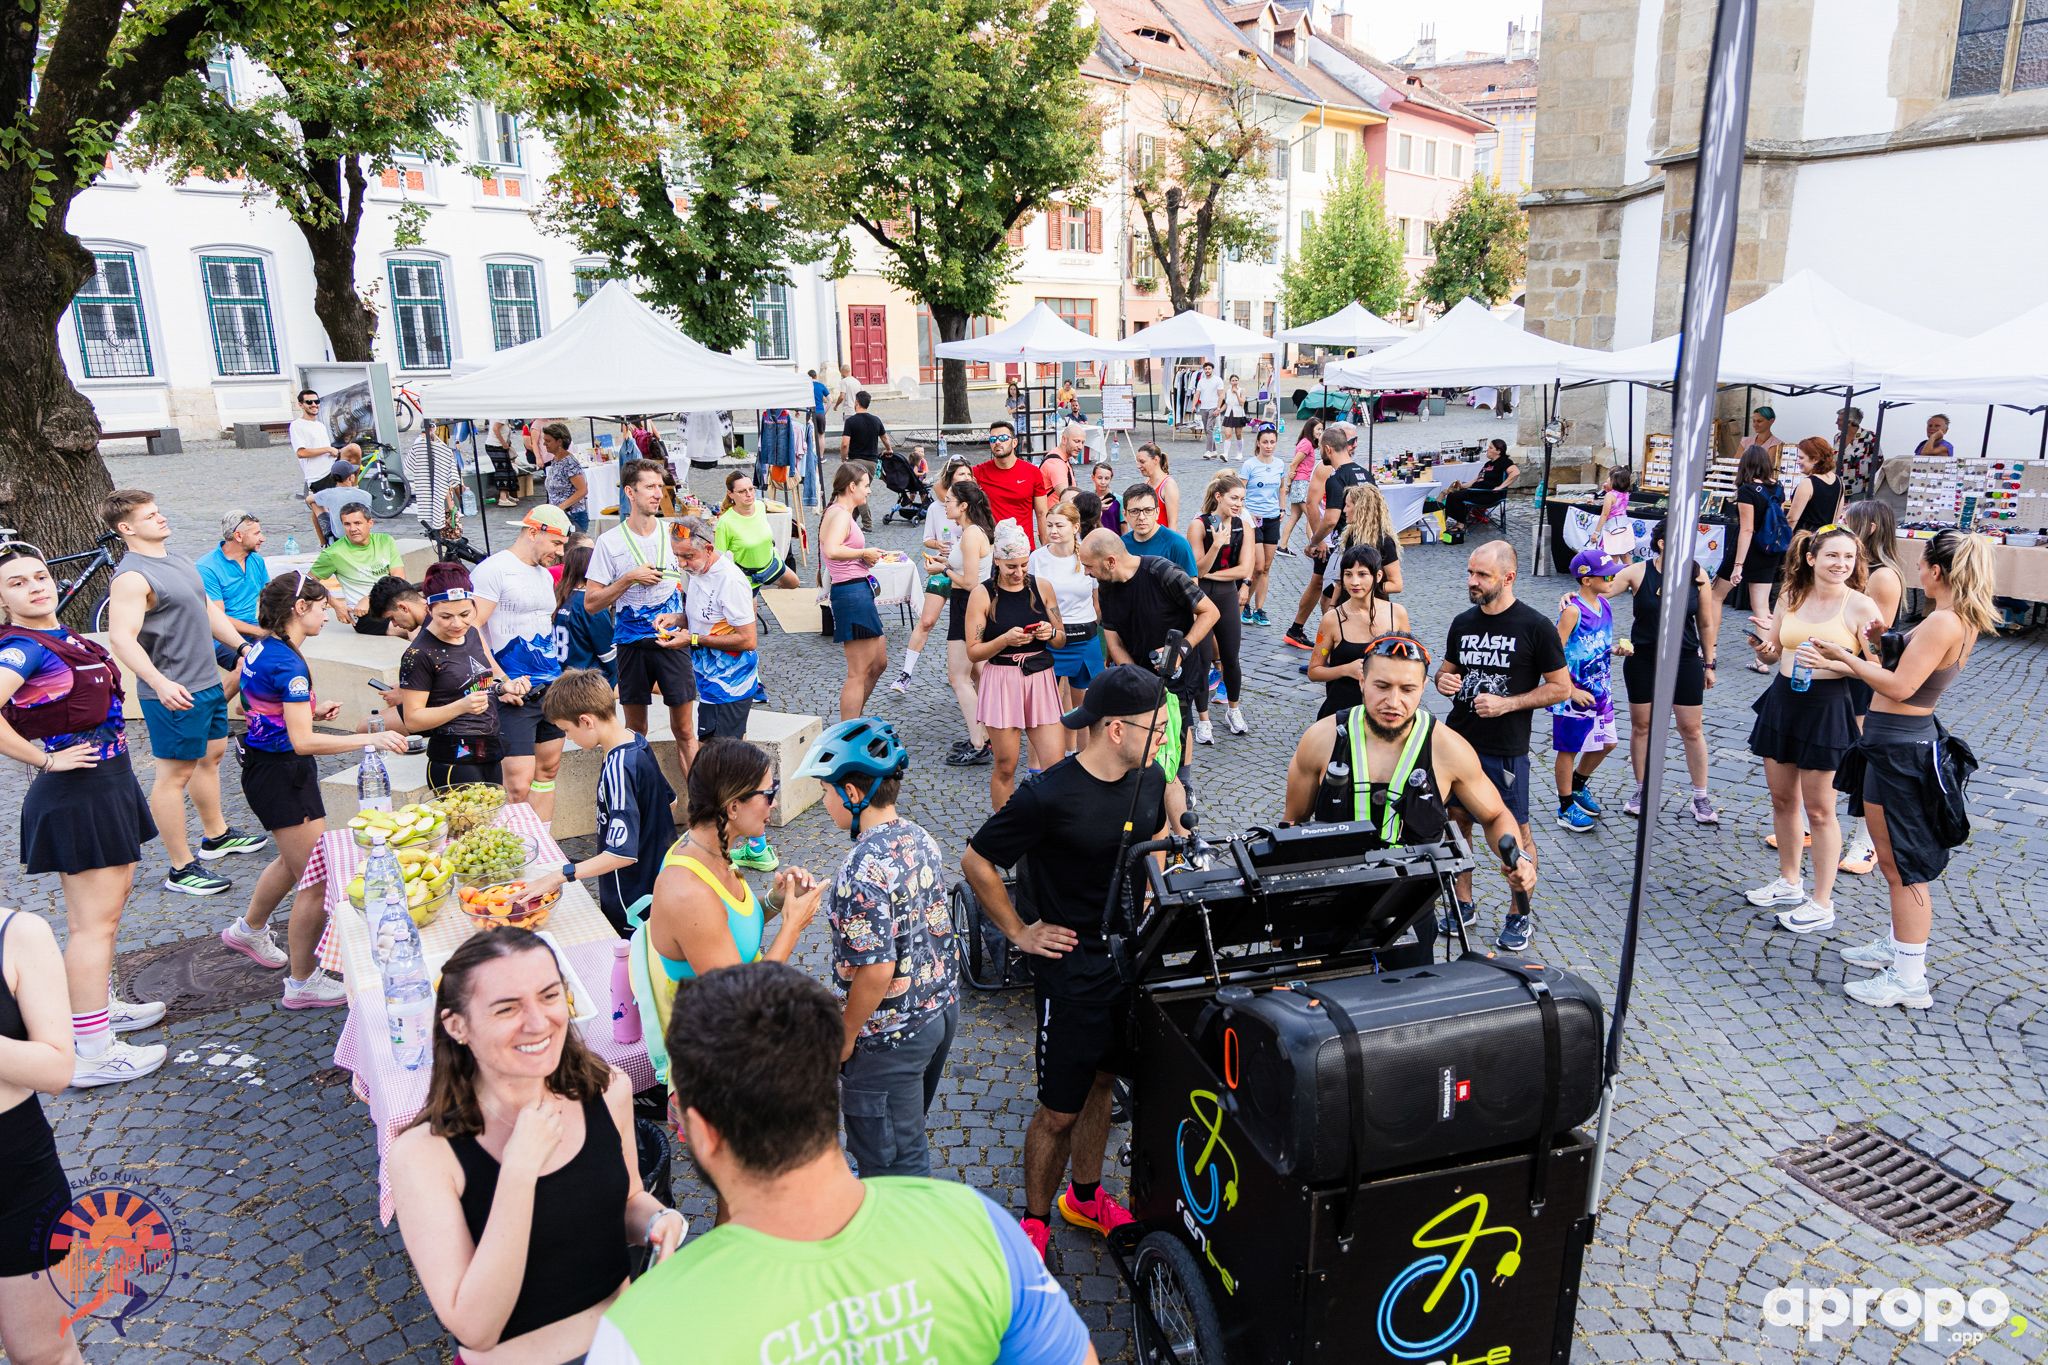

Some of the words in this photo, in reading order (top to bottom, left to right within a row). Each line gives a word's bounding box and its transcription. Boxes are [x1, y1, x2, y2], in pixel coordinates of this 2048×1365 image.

[1460, 632, 1516, 652] TRASH
[1459, 650, 1511, 668] METAL
[1301, 826, 1338, 835] Pioneer
[760, 1279, 933, 1365] CLUBUL
